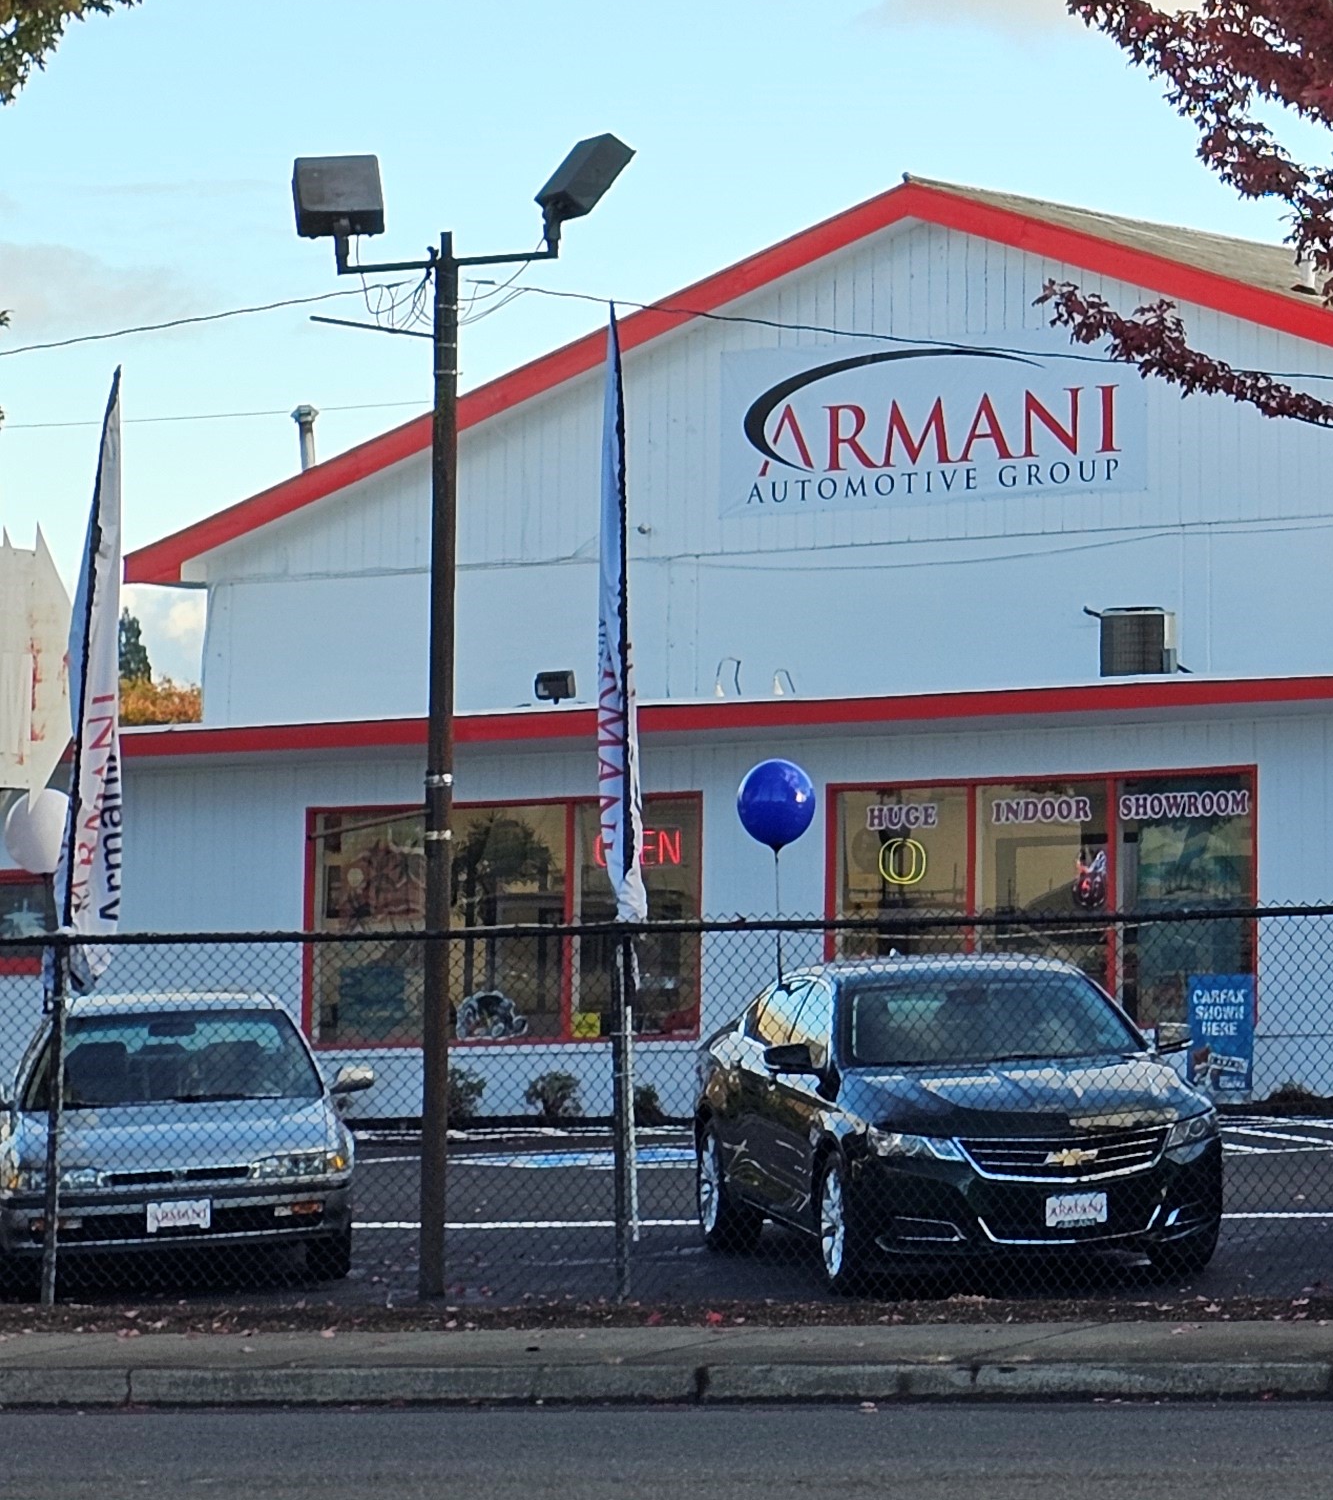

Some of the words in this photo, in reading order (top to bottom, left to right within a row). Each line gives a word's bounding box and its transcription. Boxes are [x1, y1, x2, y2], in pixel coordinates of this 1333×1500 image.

[757, 384, 1122, 477] ARMANI
[746, 467, 978, 504] AUTOMOTIVE
[998, 458, 1119, 488] GROUP
[867, 802, 938, 831] HUGE
[992, 797, 1092, 824] INDOOR
[1119, 791, 1249, 820] SHOWROOM
[1193, 989, 1247, 1004] CARFAX
[1195, 1005, 1245, 1020] SHOWN
[1201, 1021, 1239, 1036] HERE
